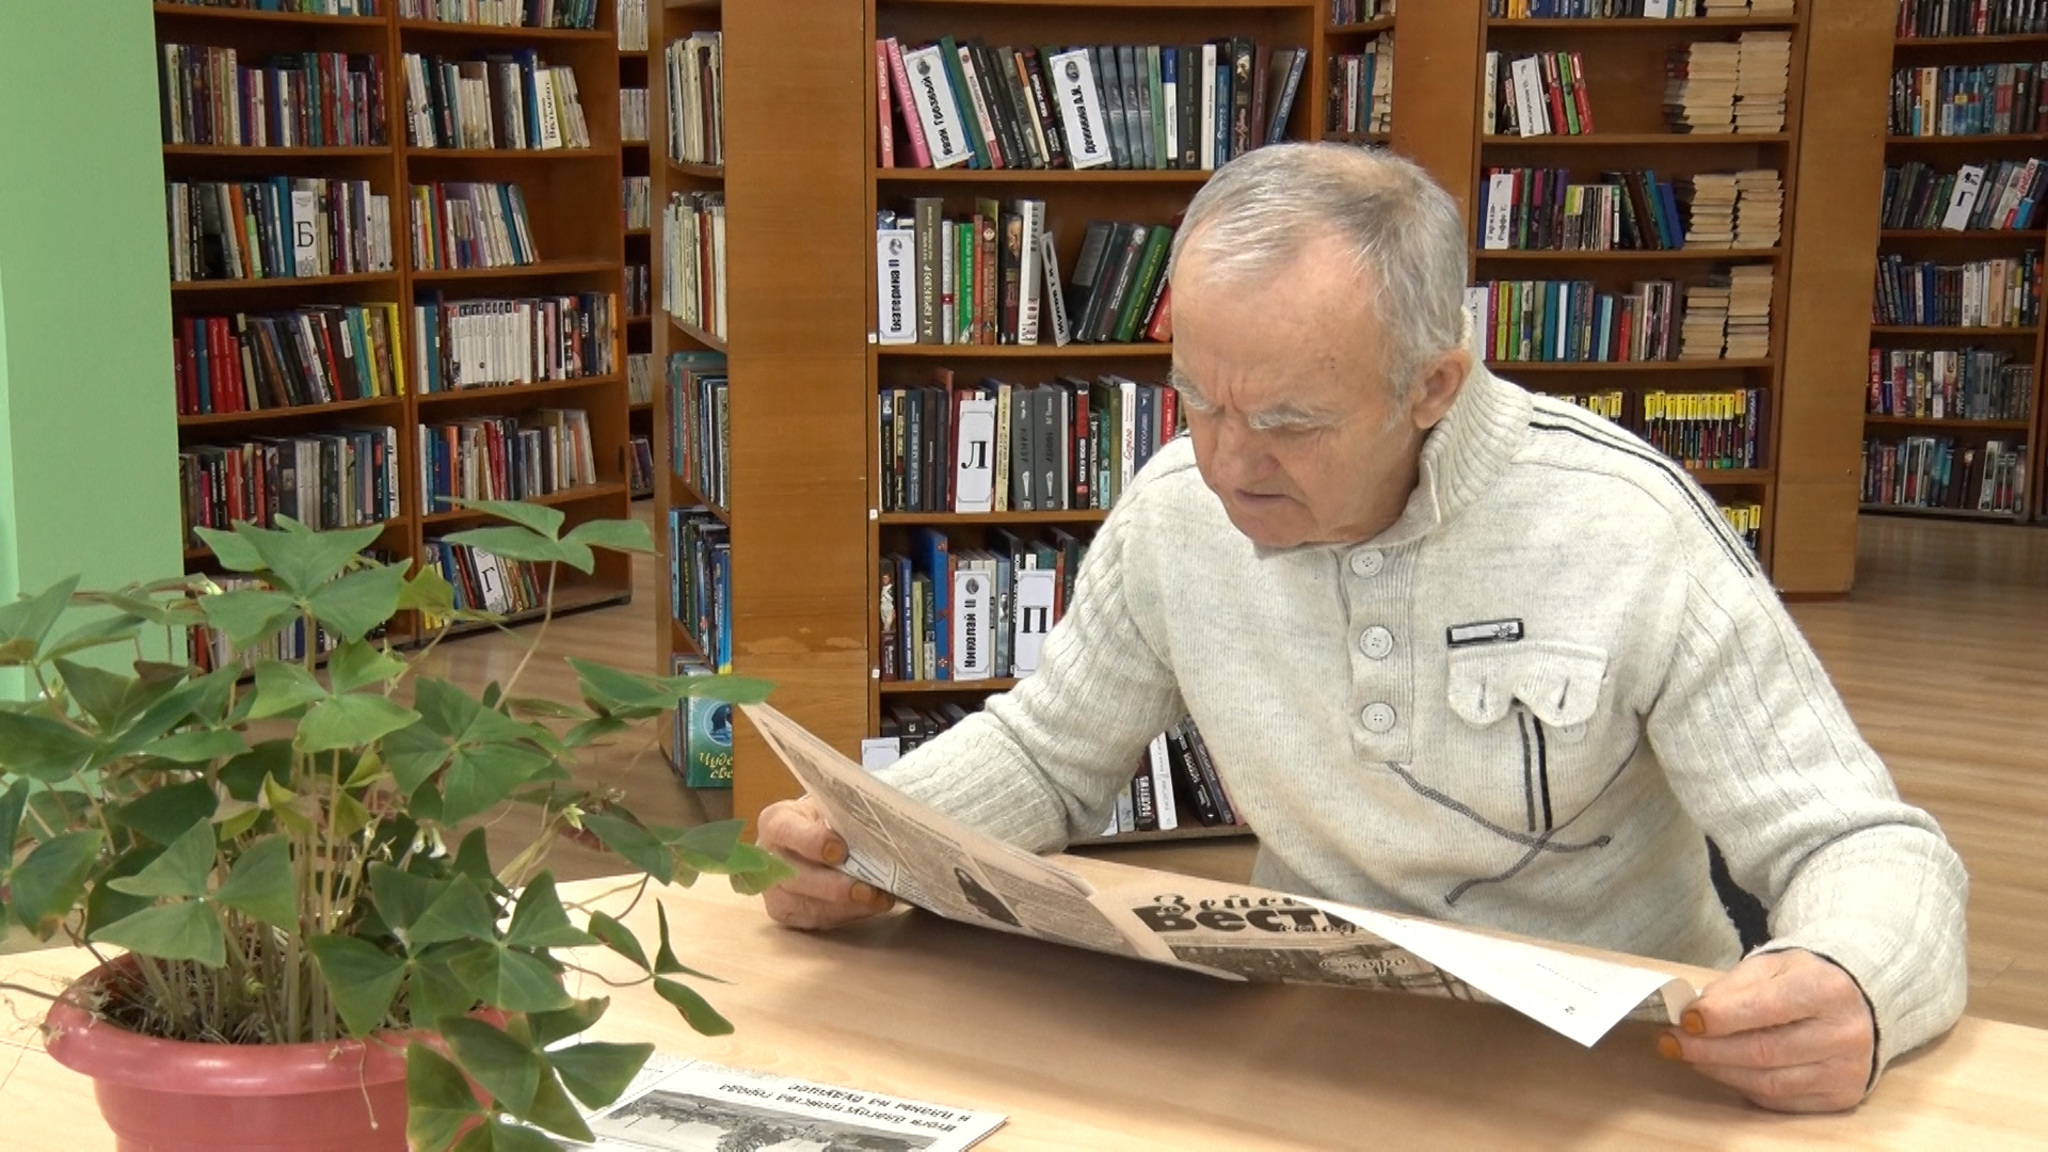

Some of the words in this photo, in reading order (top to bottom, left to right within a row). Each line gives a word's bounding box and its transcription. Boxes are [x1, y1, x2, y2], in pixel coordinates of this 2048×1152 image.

[920, 75, 945, 127] Грозный
[936, 127, 954, 156] Иван
[296, 221, 314, 248] Б
[890, 269, 902, 333] Екатерина
[961, 440, 989, 470] Л
[481, 566, 496, 593] Г
[964, 598, 976, 608] II
[1020, 606, 1048, 634] П
[963, 613, 977, 668] Николай
